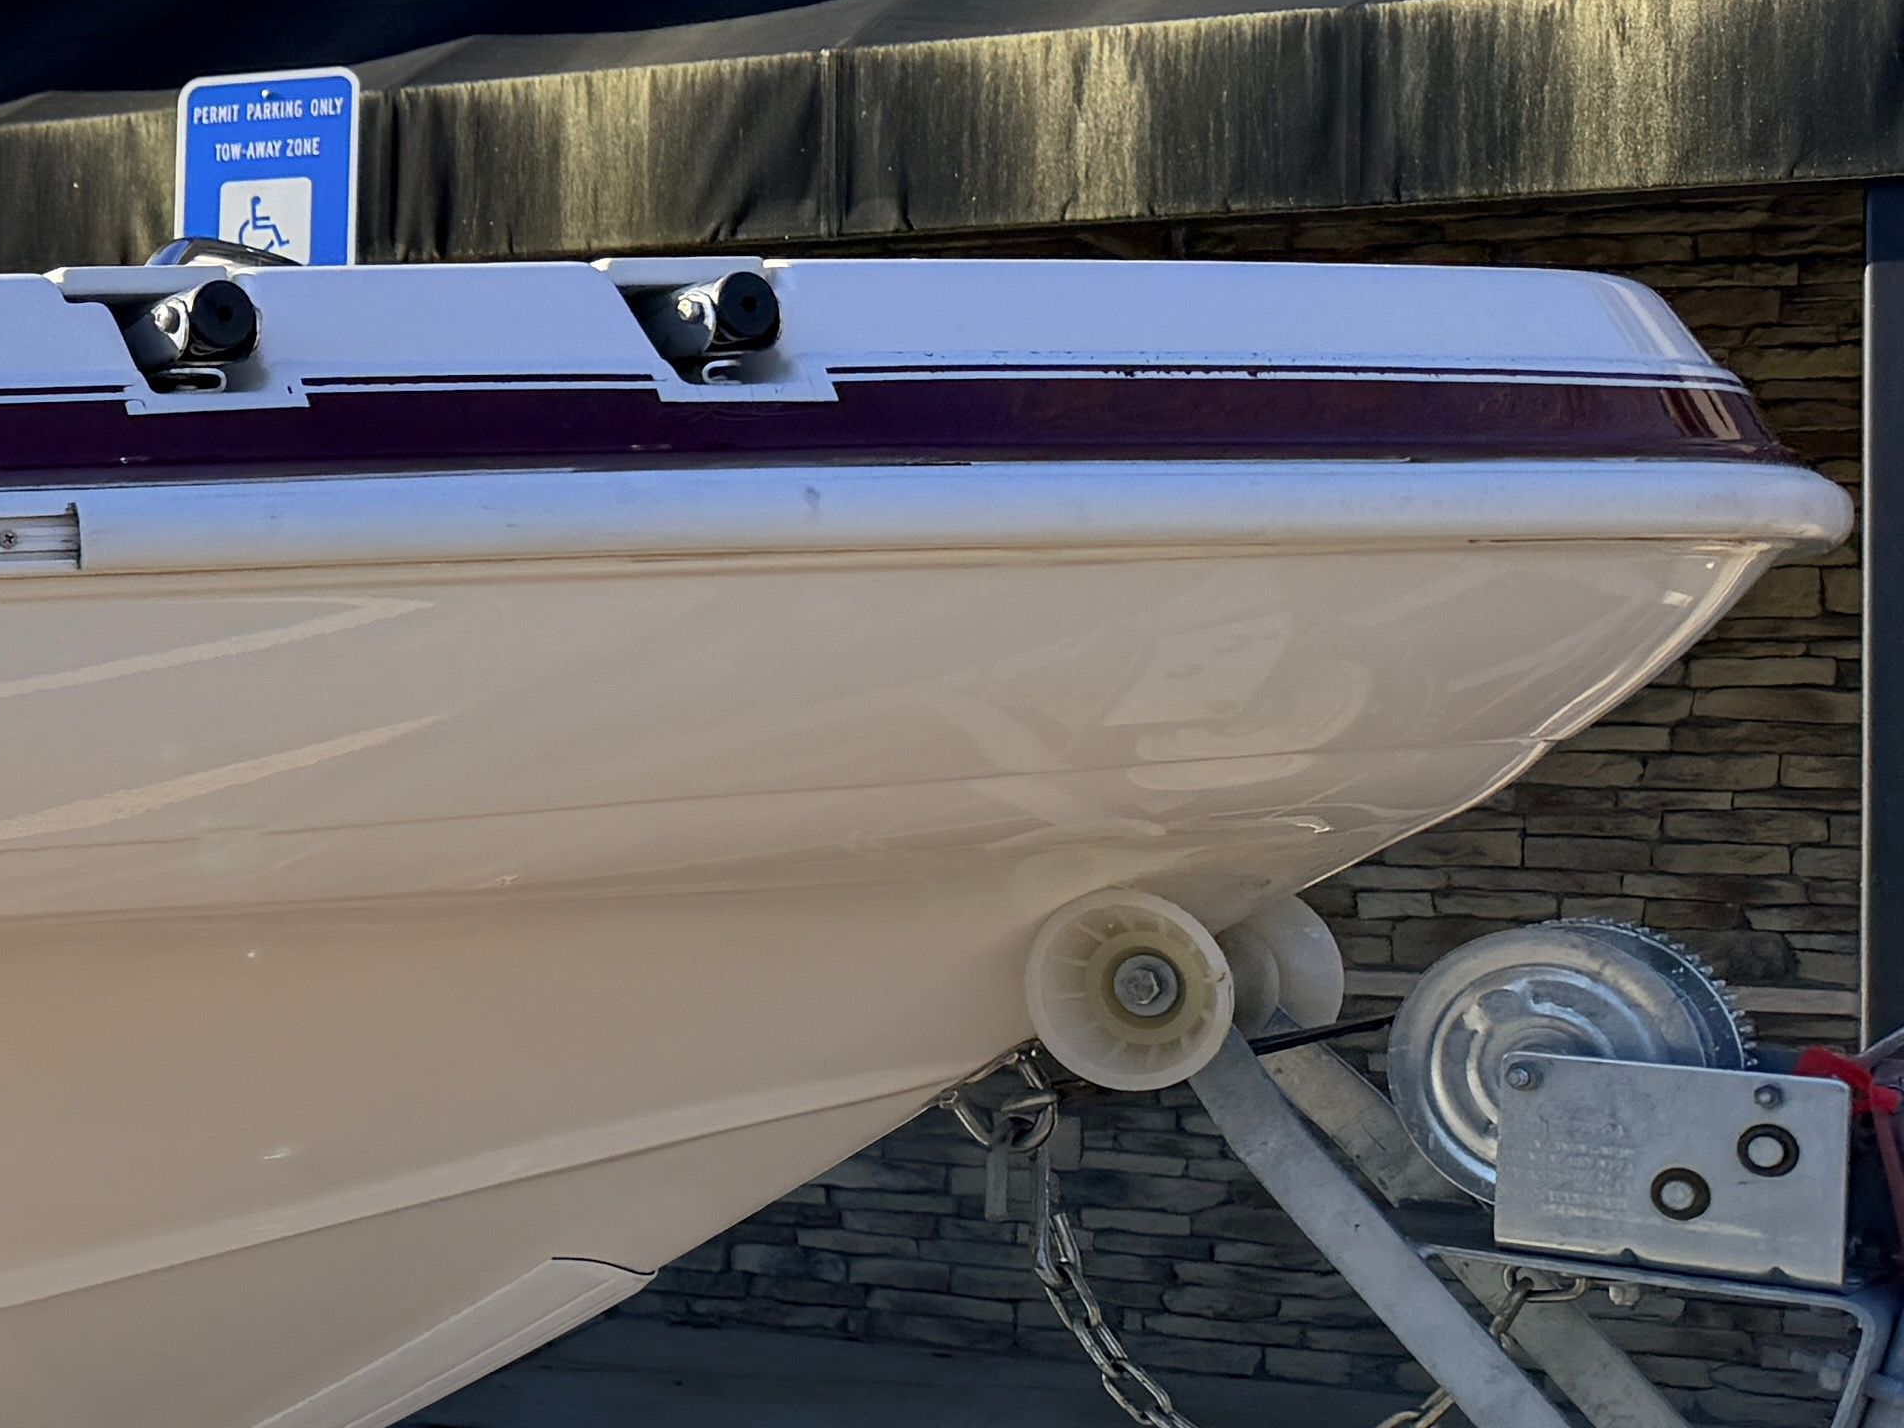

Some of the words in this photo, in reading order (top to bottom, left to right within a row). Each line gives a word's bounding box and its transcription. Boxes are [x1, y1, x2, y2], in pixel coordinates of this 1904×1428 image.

[193, 104, 240, 125] PERMIT
[246, 99, 303, 121] PARKING
[310, 97, 344, 118] ONLY
[215, 140, 282, 162] TOW-AWAY
[286, 137, 320, 157] ZONE
